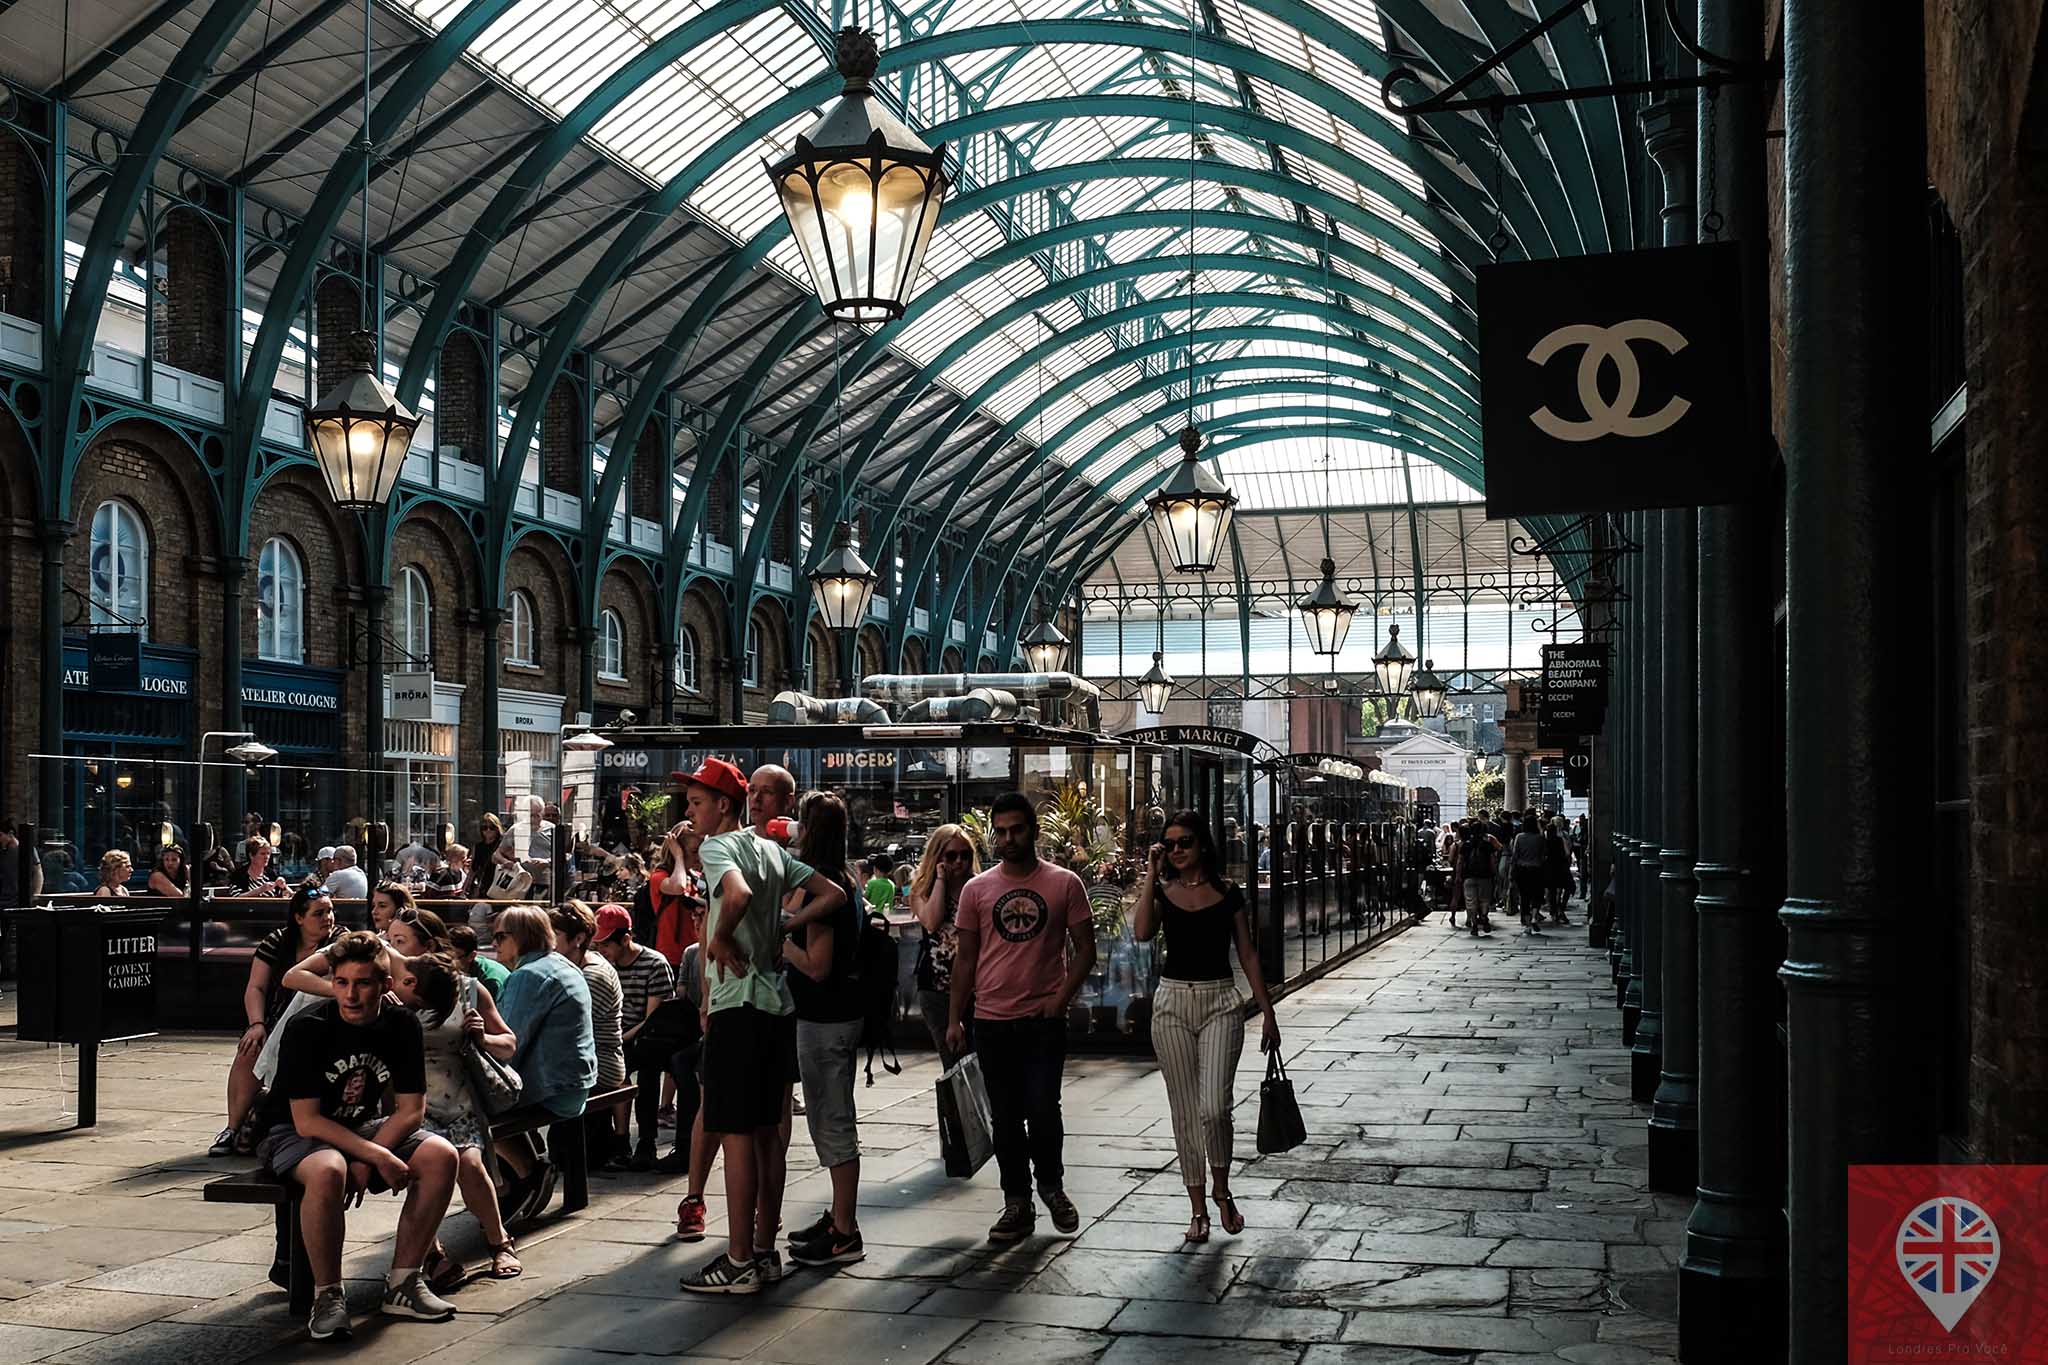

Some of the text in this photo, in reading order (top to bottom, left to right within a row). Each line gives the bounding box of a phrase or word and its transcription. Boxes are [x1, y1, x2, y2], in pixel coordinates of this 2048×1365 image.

[1548, 650, 1565, 659] THE
[1548, 659, 1601, 669] ABNORMAL
[1548, 669, 1583, 679] BEAUTY
[141, 677, 187, 695] LOGNE
[1548, 679, 1598, 689] COMPANY.
[240, 687, 337, 709] ATELIER COLOGNE
[515, 716, 534, 726] BRORA
[1178, 728, 1243, 747] MARKET
[603, 752, 649, 767] BOHO
[827, 752, 893, 768] BURGERS
[107, 936, 155, 955] LITTER
[108, 962, 151, 976] COVENT
[108, 974, 151, 989] GARDEN
[325, 1071, 339, 1083] A
